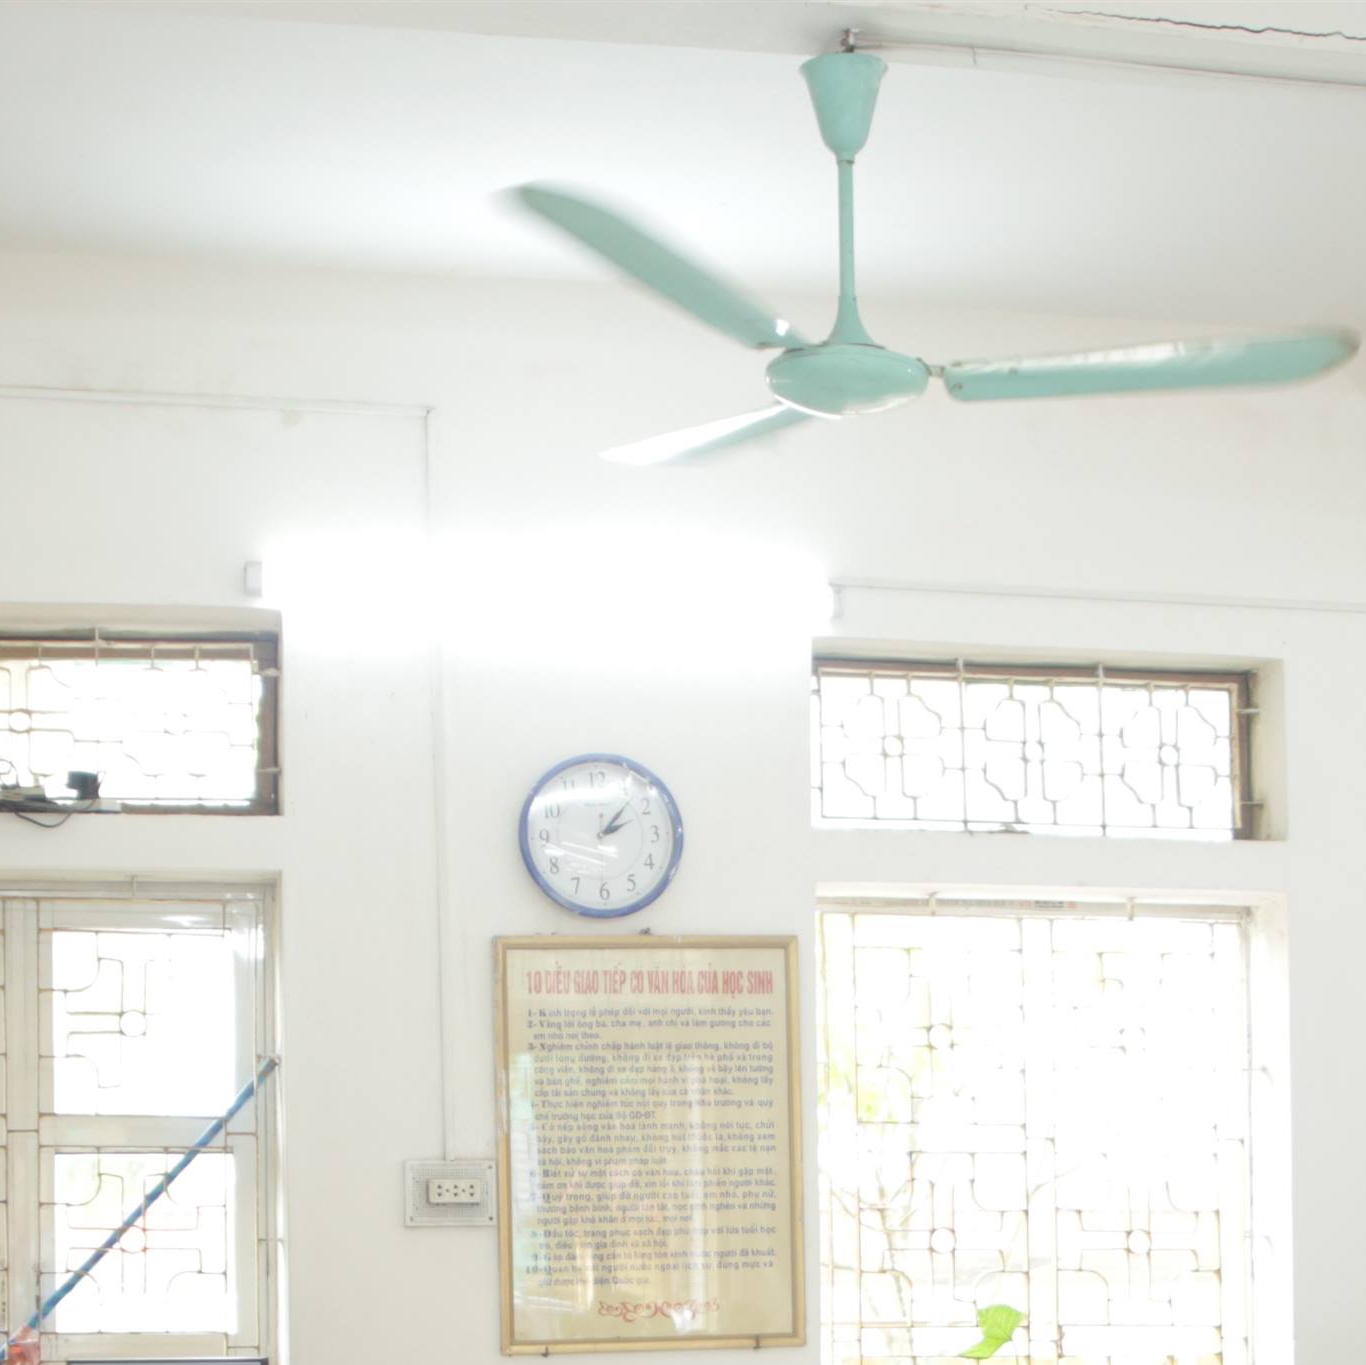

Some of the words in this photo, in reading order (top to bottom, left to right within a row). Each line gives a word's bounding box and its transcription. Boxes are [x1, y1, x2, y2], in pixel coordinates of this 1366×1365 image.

[588, 770, 606, 787] 12
[544, 804, 561, 819] 10
[641, 798, 651, 815] 2
[538, 828, 550, 845] 9
[649, 825, 660, 843] 3
[549, 856, 560, 874] 8
[643, 853, 655, 870] 4
[570, 876, 581, 895] 7
[599, 881, 611, 900] 6
[626, 873, 637, 892] 5
[526, 970, 542, 994] 10
[573, 970, 599, 994] GIAO
[603, 961, 627, 994] TIẾP
[647, 966, 669, 994] VĂN
[697, 962, 719, 994] CỦA
[722, 970, 743, 999] HỌC
[747, 970, 773, 994] SINH
